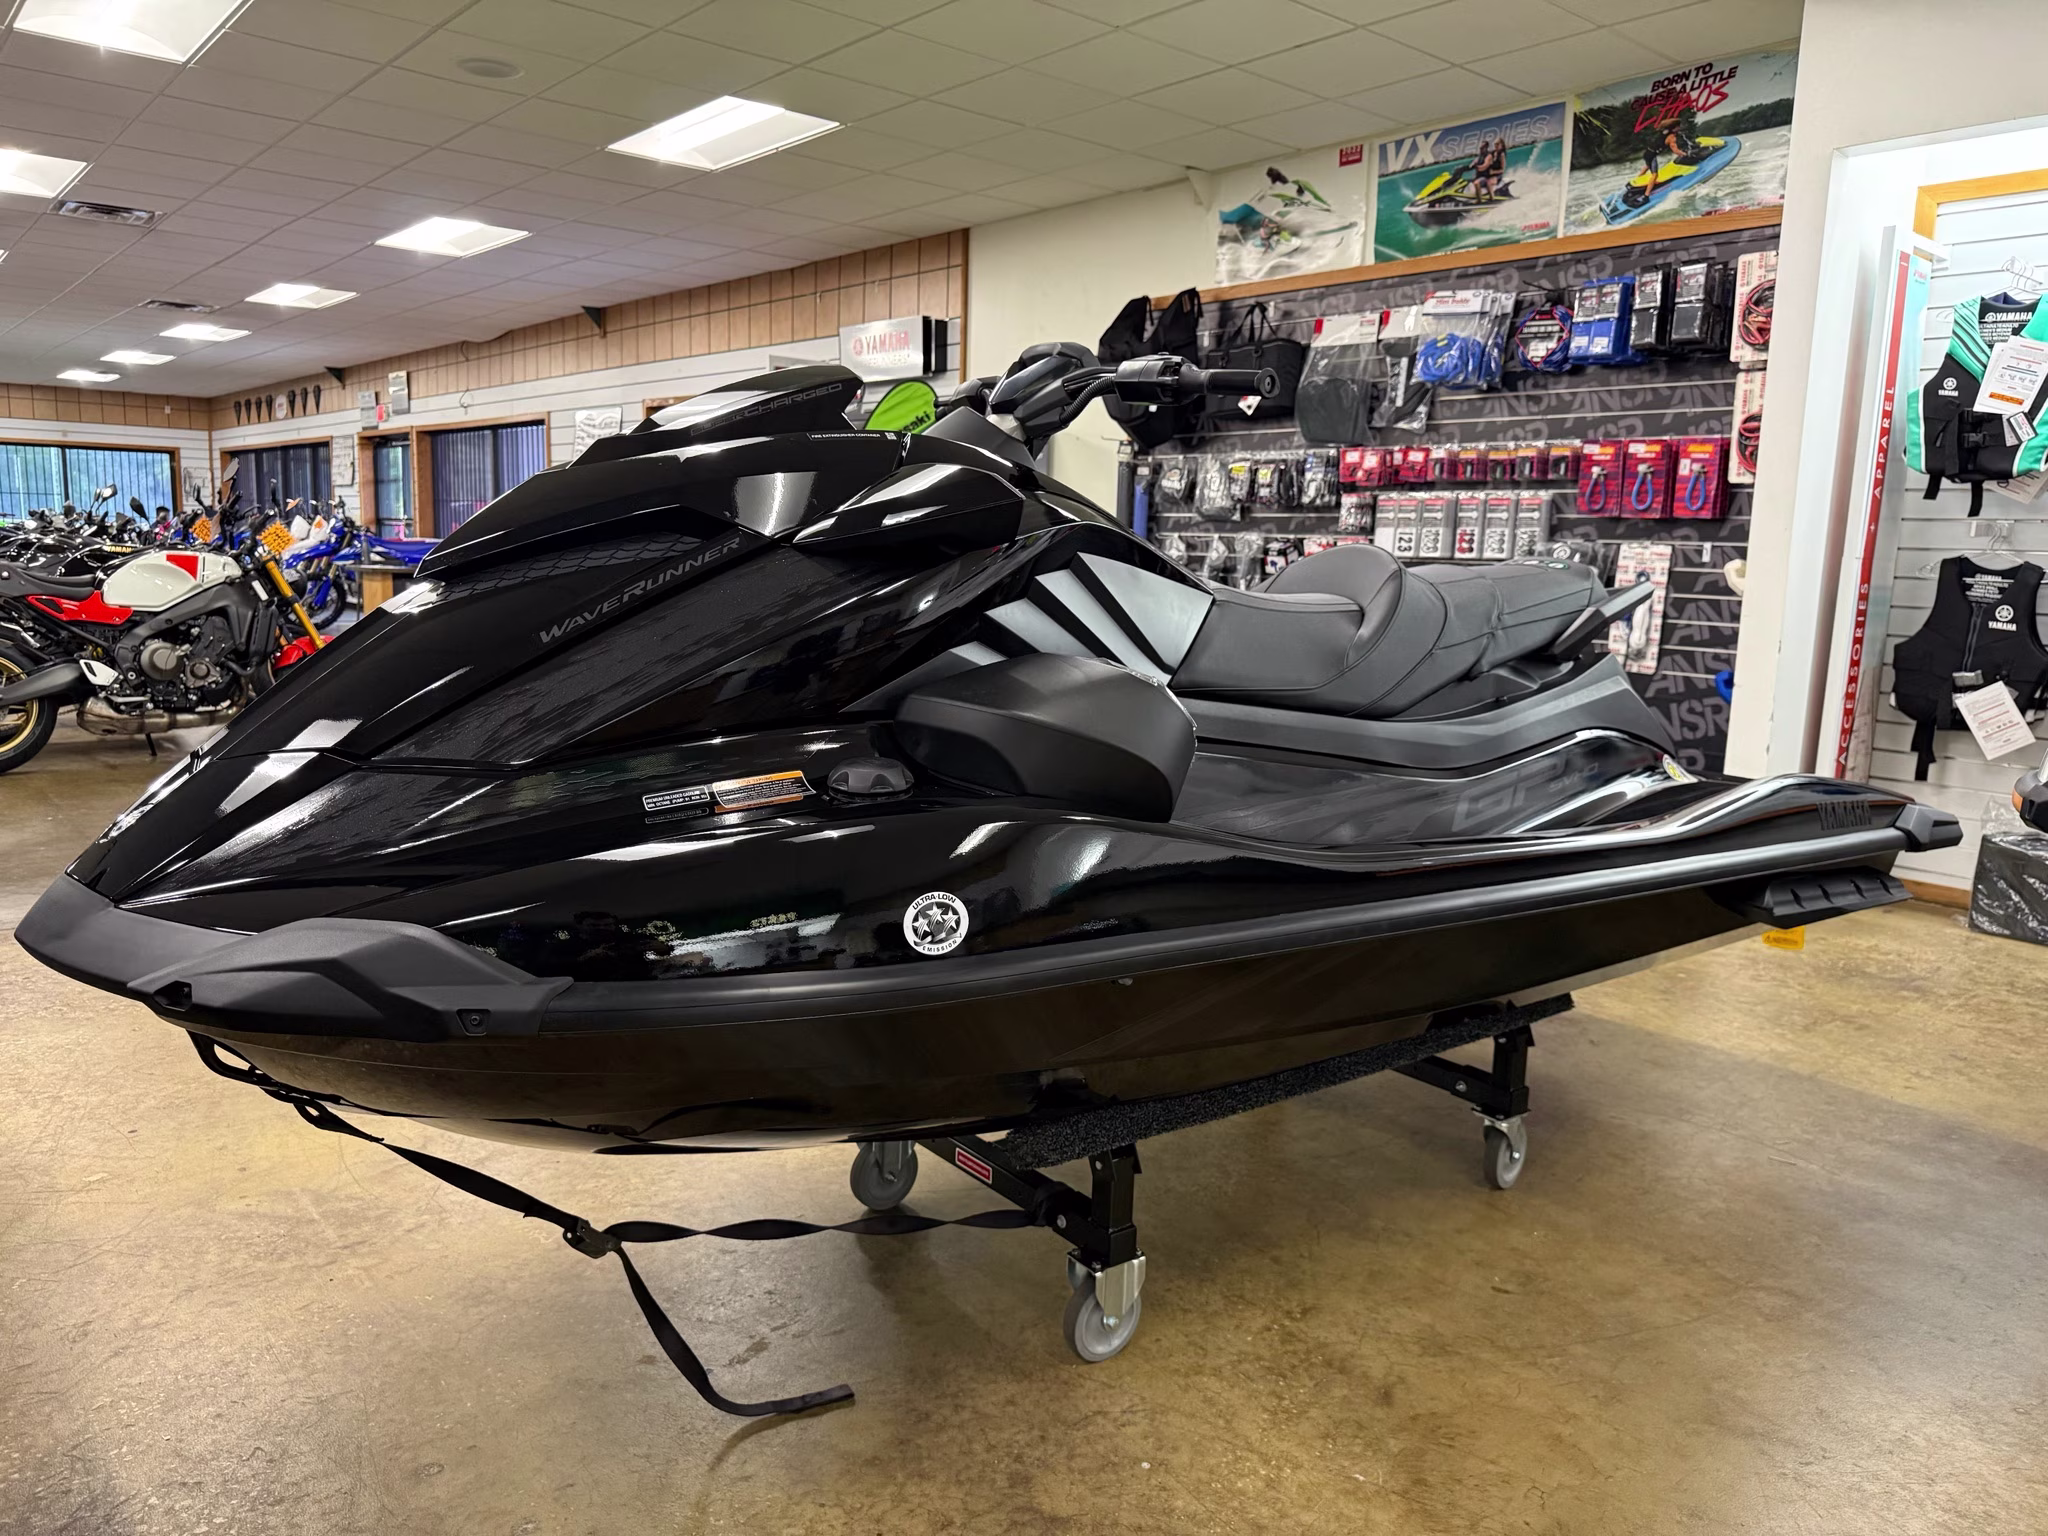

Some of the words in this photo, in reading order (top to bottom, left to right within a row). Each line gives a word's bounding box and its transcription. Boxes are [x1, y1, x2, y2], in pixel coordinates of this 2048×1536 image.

[1630, 86, 1678, 111] CAUSE
[1689, 65, 1739, 92] LITTLE
[1650, 68, 1692, 93] BORN
[1693, 62, 1714, 79] TO
[1633, 80, 1730, 133] CHAOS
[1386, 130, 1442, 172] VX
[1439, 114, 1551, 161] SERIES
[1996, 311, 2033, 321] YAMAHA
[864, 330, 910, 356] YAMAHA
[1938, 389, 1959, 397] YAMAHA
[690, 383, 843, 436] SUPERCHARGED
[902, 410, 931, 433] saki
[1397, 531, 1414, 553] 123
[539, 537, 741, 644] WAVERUNNER
[1837, 582, 1870, 768] ACCESSORIES
[1872, 384, 1897, 500] APPAREL
[1988, 620, 2017, 632] YAMAHA
[1452, 751, 1567, 832] GP
[1816, 799, 1872, 831] YAMAHA
[922, 939, 958, 953] EMISSION
